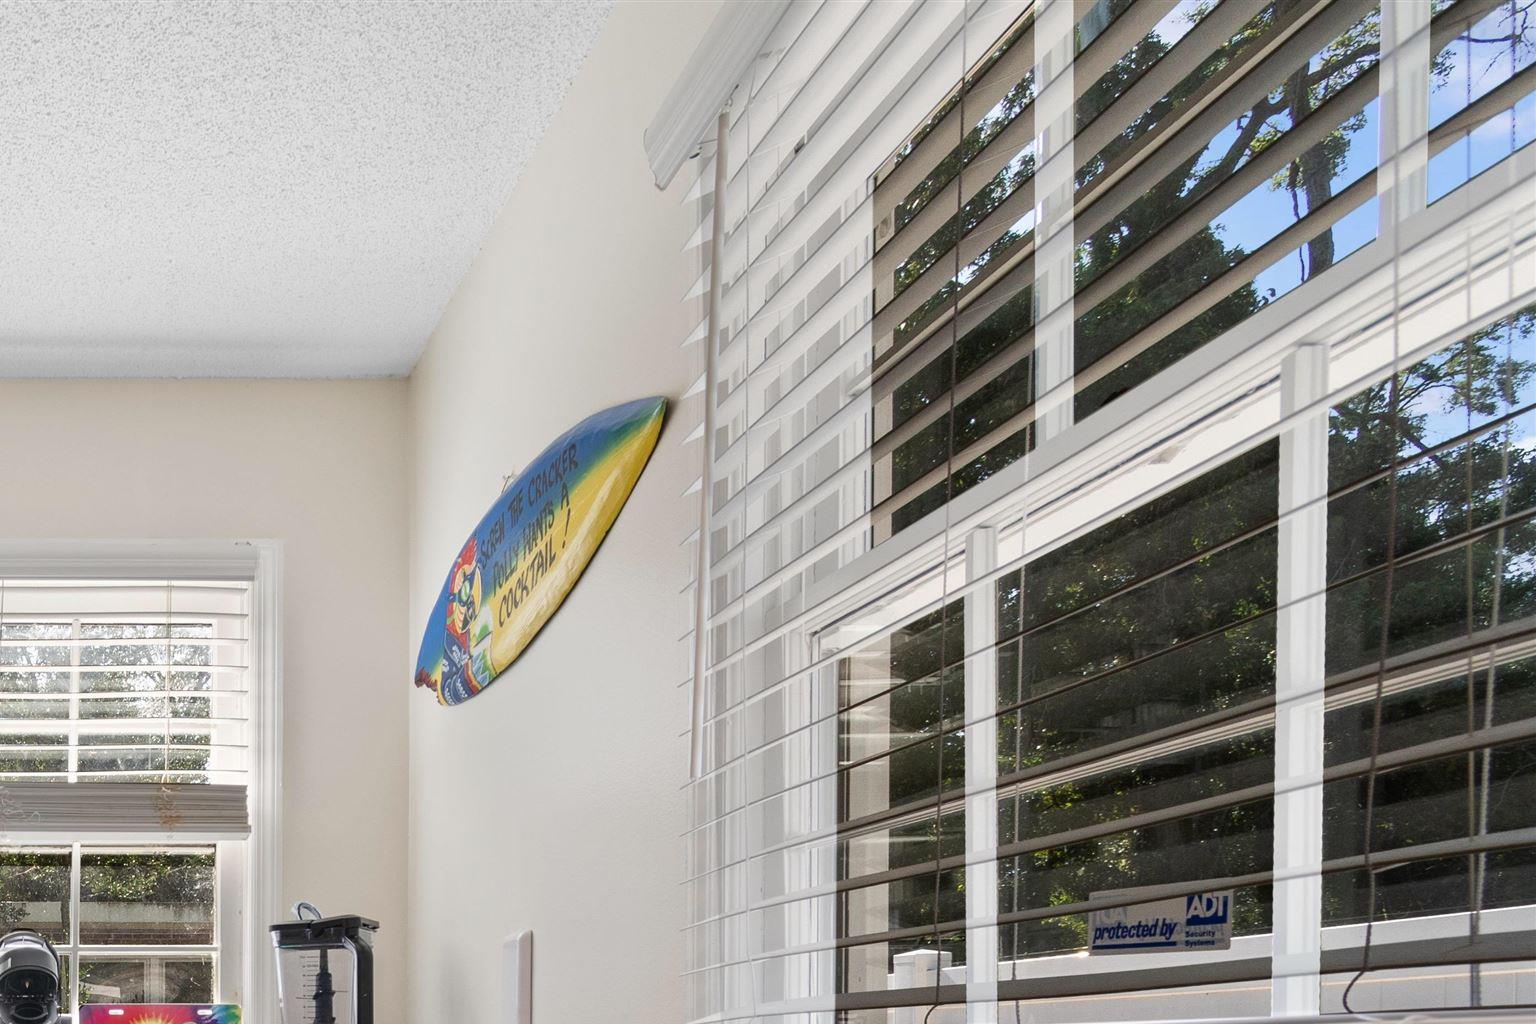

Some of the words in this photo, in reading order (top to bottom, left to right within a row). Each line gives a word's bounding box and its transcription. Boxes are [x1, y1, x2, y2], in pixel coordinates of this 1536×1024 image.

[479, 514, 505, 567] SCREW
[507, 488, 524, 523] THE
[527, 442, 579, 508] CRACKER
[492, 548, 520, 597] POLLY
[522, 504, 555, 557] WANTS
[559, 484, 570, 510] A
[498, 534, 557, 629] COCKTAIL
[1092, 918, 1159, 944] protected
[1159, 918, 1177, 941] by
[1185, 894, 1226, 919] ADT
[1185, 930, 1216, 938] Security
